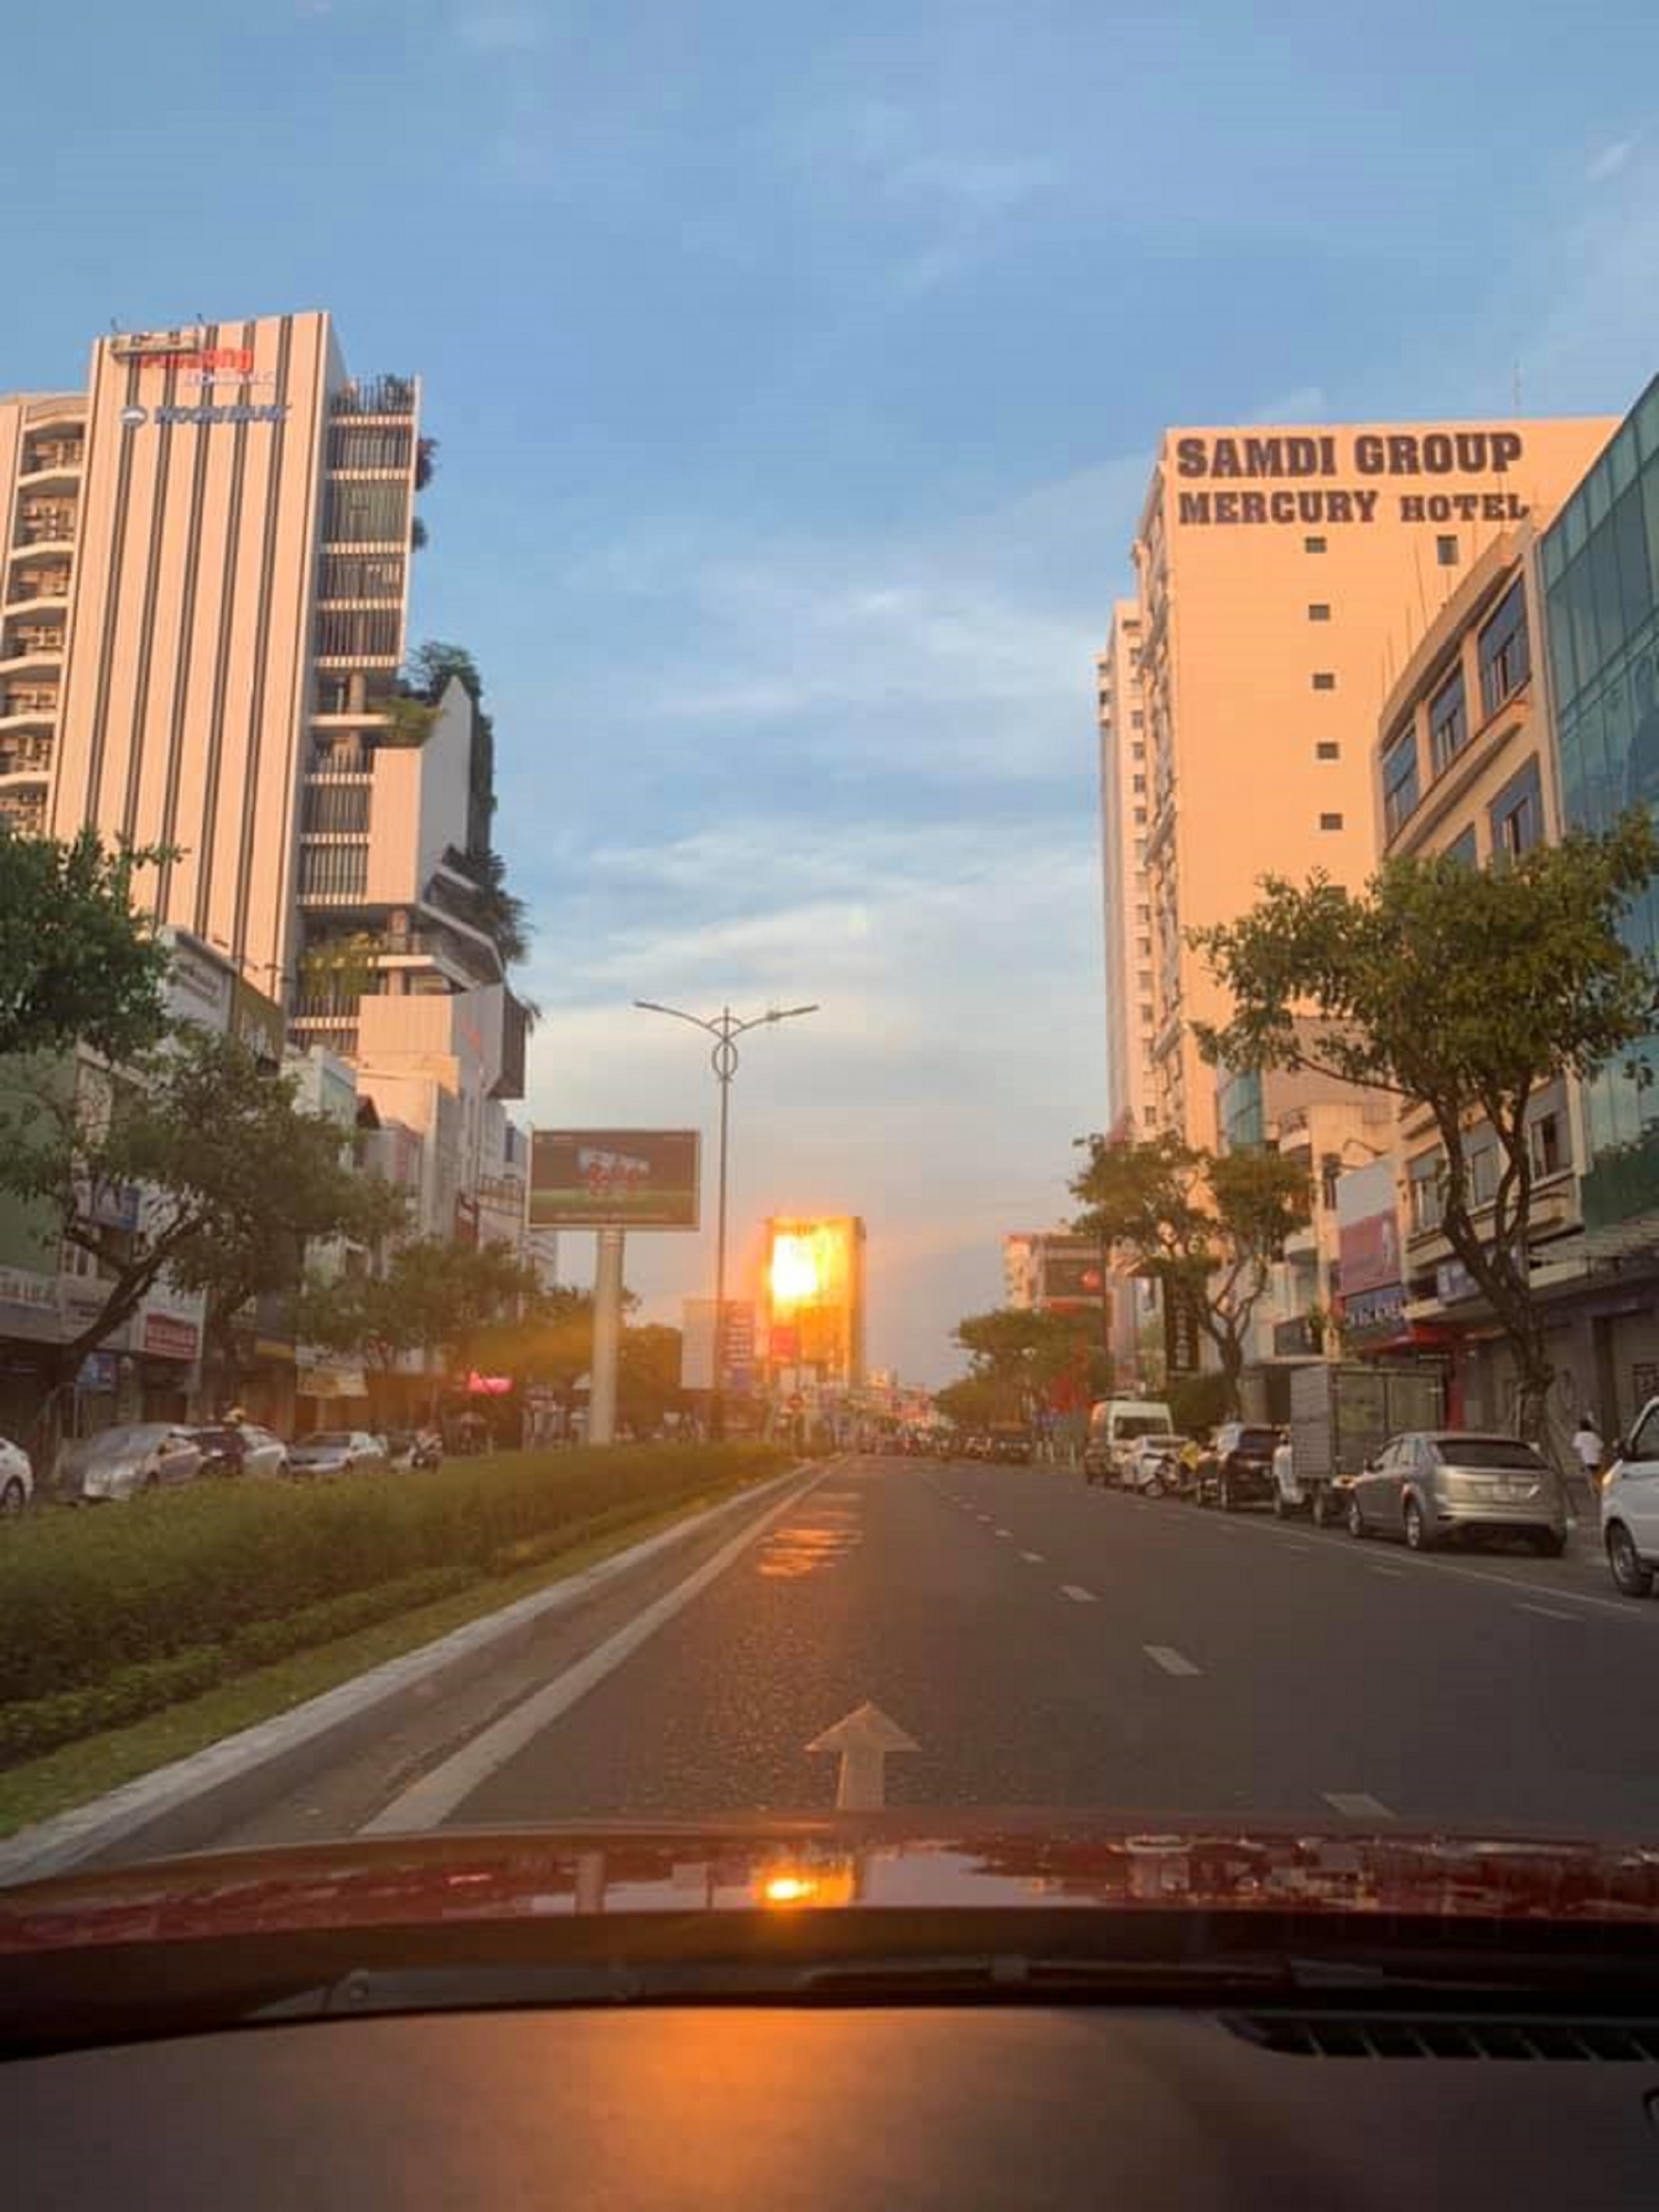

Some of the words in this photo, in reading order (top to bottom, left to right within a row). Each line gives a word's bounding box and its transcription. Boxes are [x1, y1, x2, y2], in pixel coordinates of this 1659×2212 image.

[1177, 436, 1337, 478] SAMDI
[1354, 432, 1522, 475] GROUP
[1179, 490, 1378, 524] MERCURY
[1400, 493, 1530, 523] HOTEL
